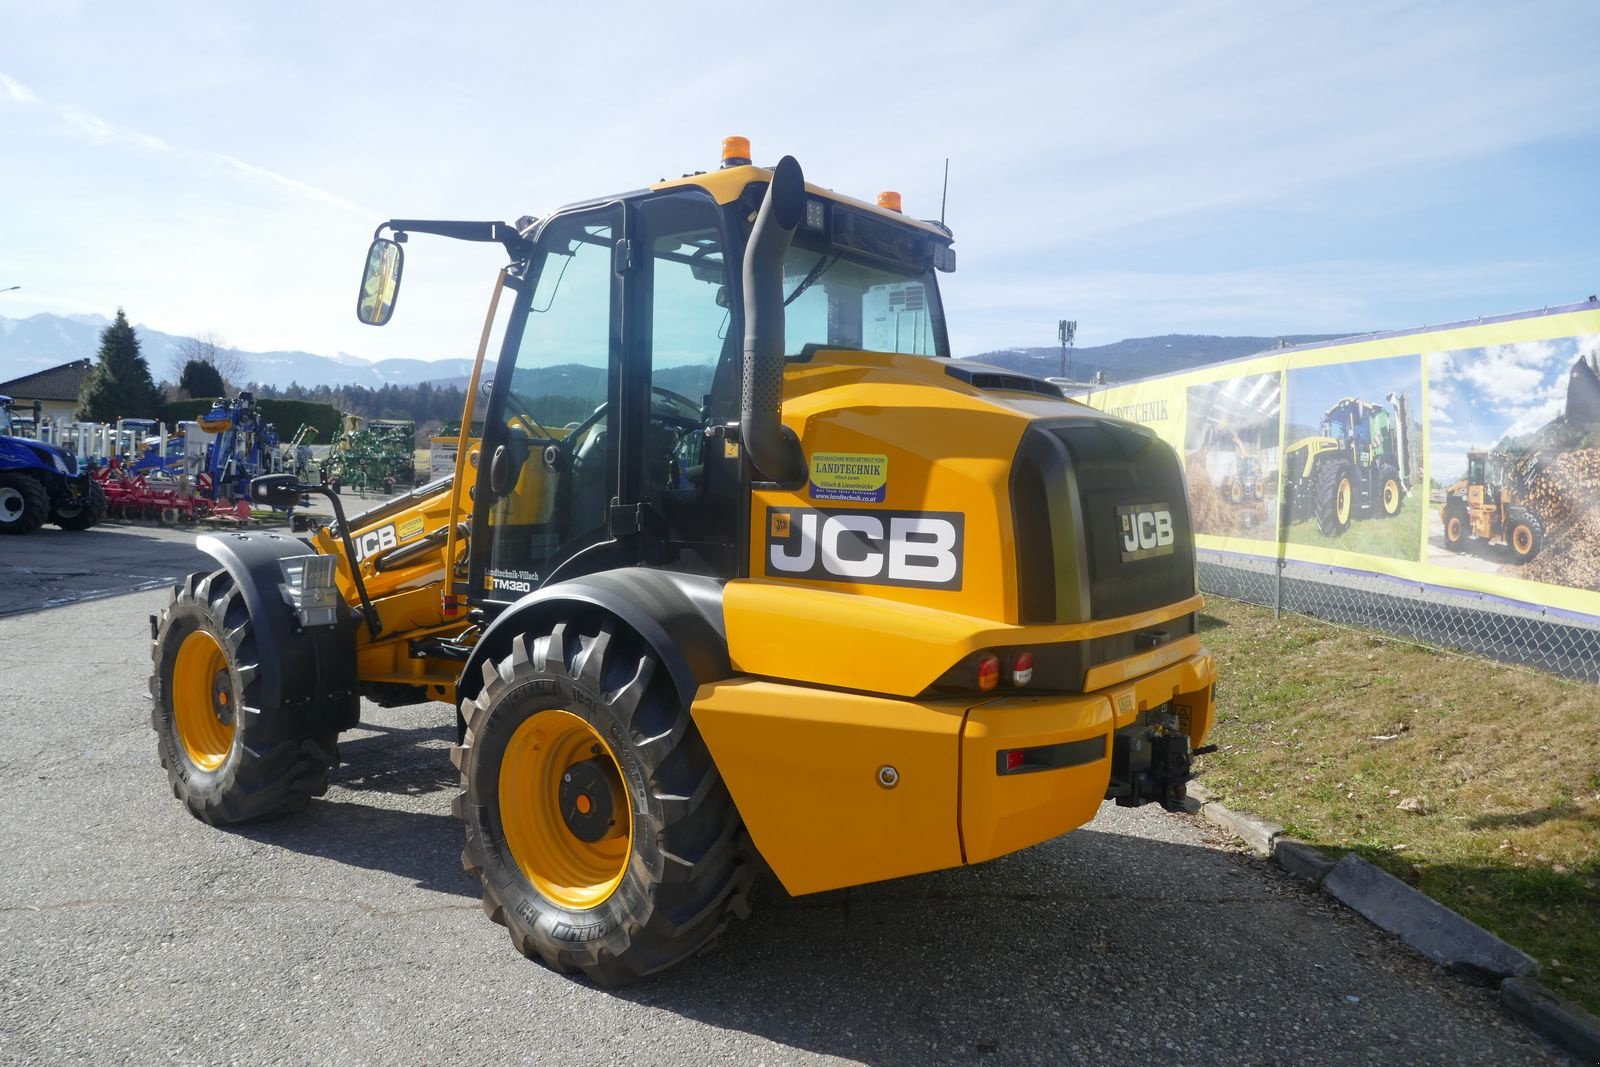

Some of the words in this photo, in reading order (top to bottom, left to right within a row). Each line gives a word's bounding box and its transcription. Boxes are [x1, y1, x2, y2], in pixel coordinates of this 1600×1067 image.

[1107, 400, 1168, 424] NDTECHNIK
[816, 463, 880, 476] LANDTECHNIK
[815, 494, 876, 502] www.landtechnik.co.at
[1123, 511, 1174, 552] JCB
[356, 525, 397, 562] JCB
[770, 514, 957, 582] JCB
[484, 568, 539, 581] Landtechnik-Villach
[493, 579, 530, 593] TM320
